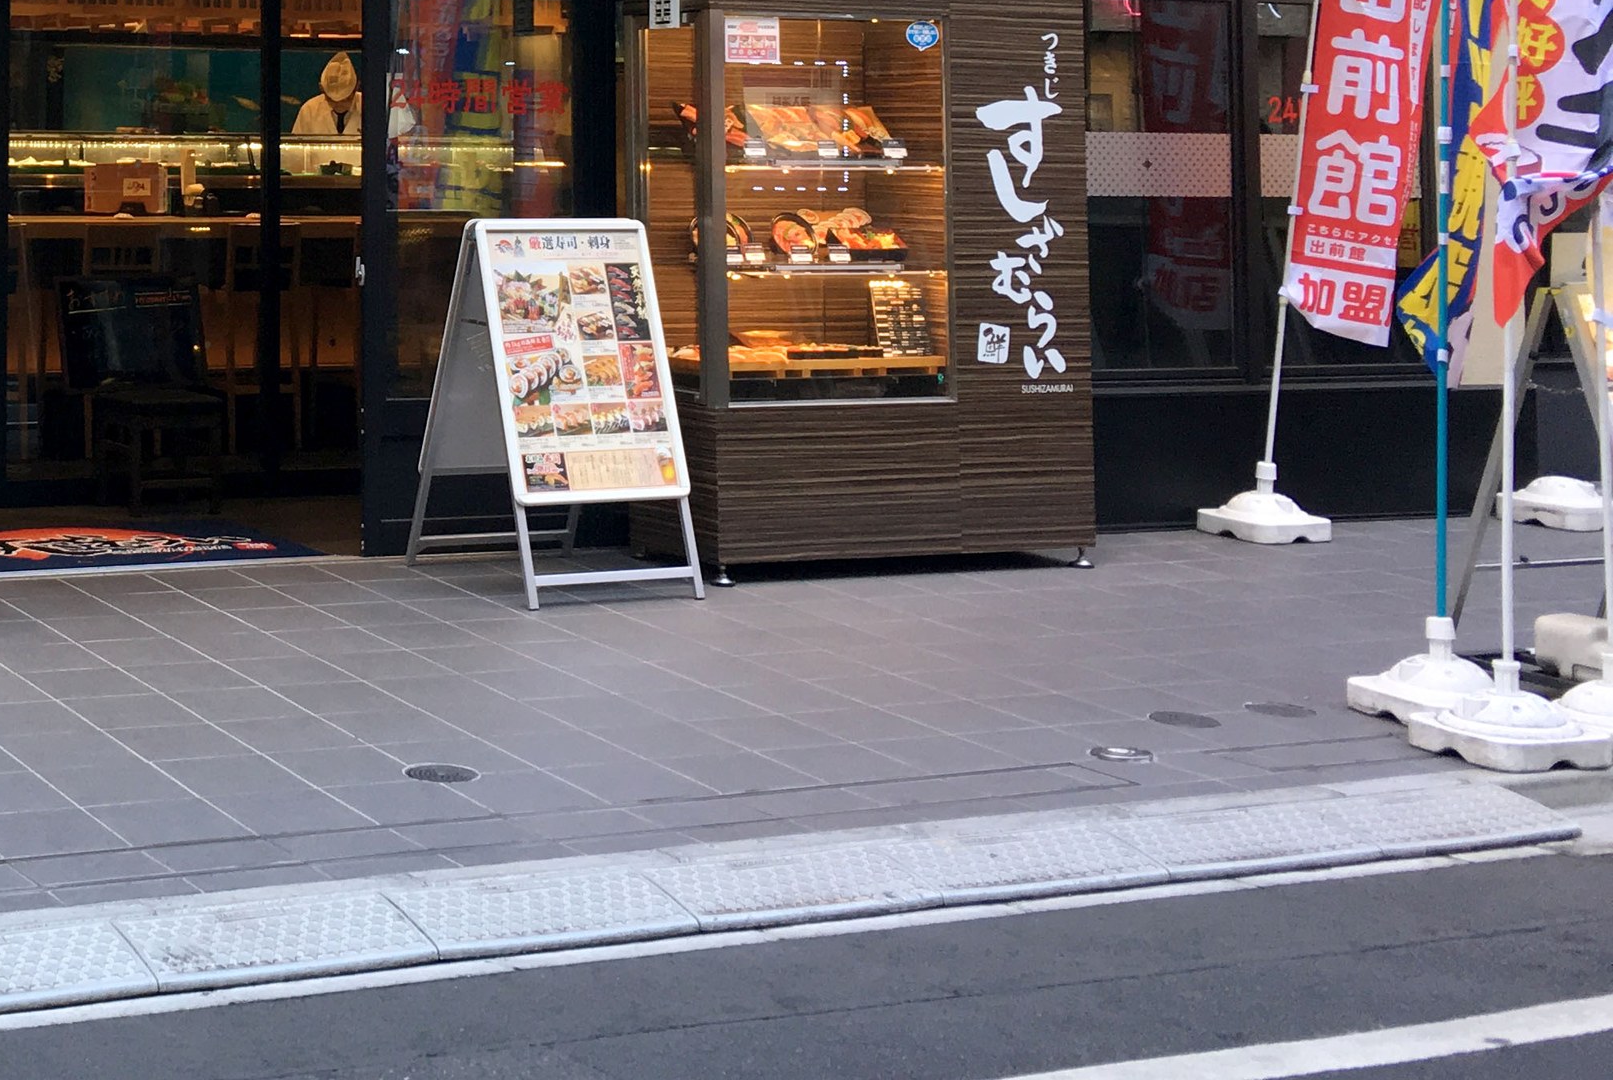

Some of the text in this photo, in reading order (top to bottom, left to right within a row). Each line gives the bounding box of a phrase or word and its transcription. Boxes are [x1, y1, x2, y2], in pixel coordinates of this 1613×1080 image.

[1040, 32, 1060, 100] つきじ
[389, 77, 569, 116] 24時間営業
[975, 85, 1067, 380] すしざむらい
[1308, 238, 1367, 263] 出前館
[1298, 272, 1395, 328] 加盟
[1021, 383, 1075, 394] SUSHIZAMURAI
